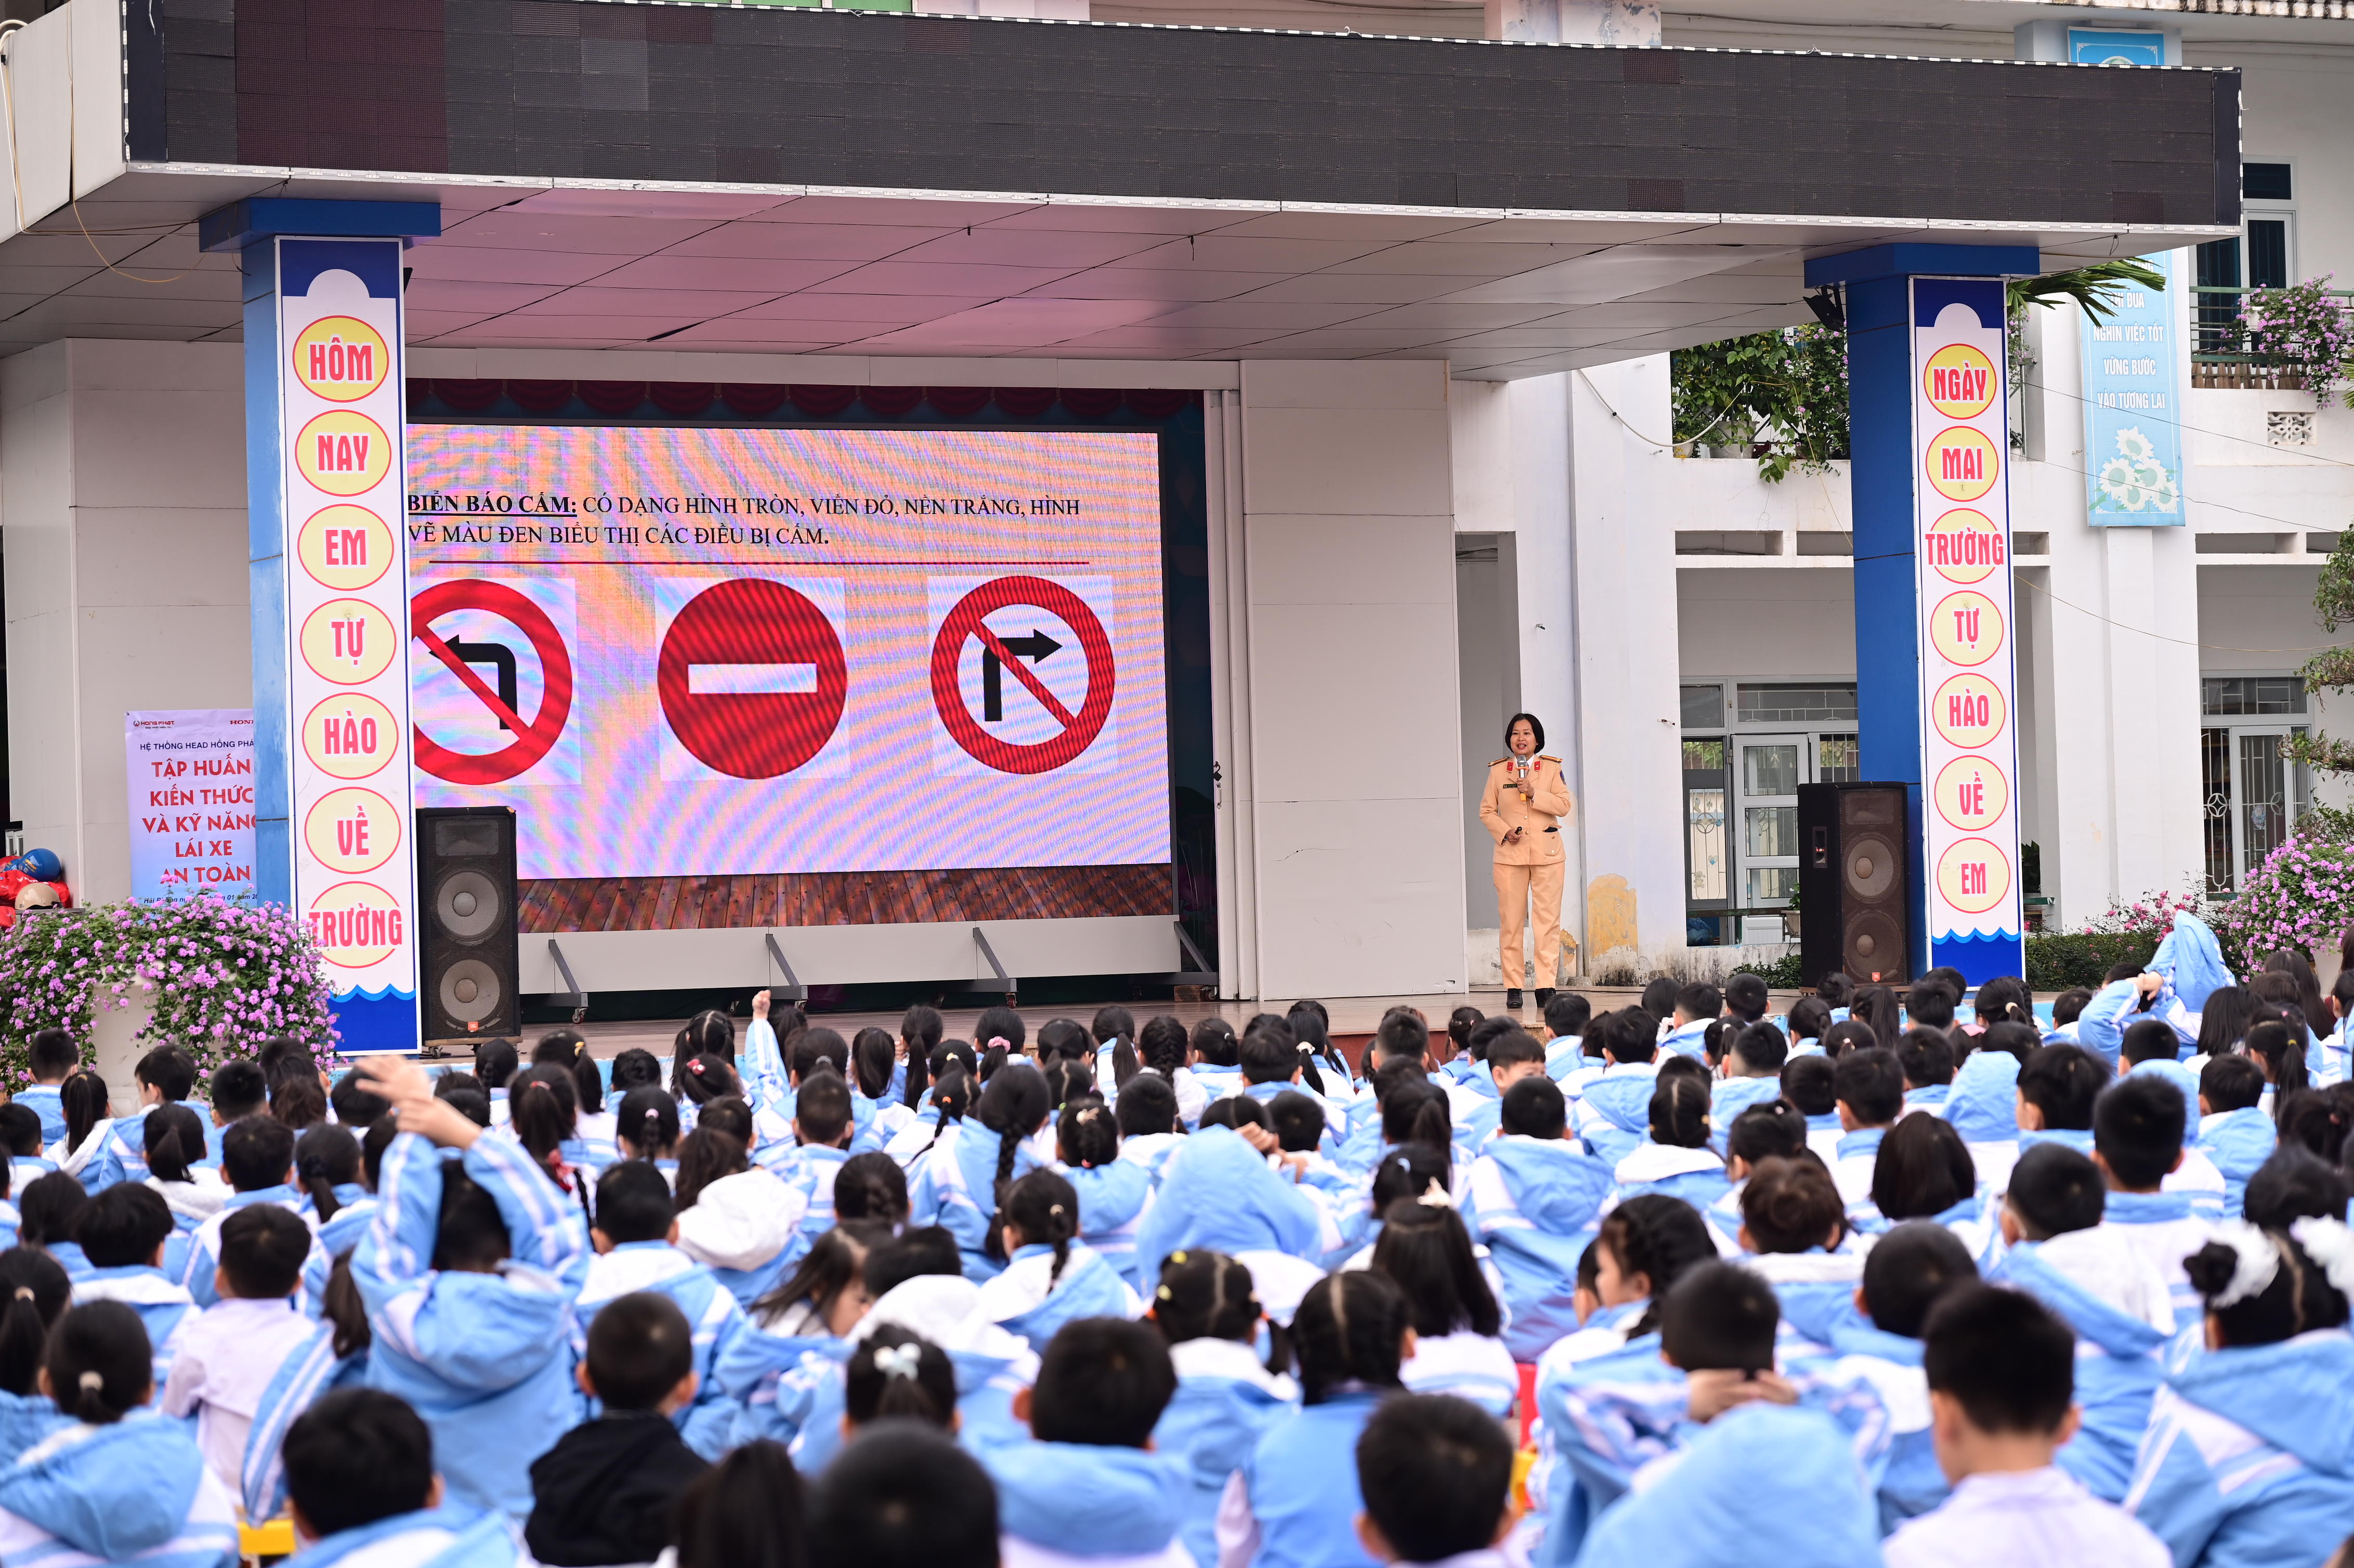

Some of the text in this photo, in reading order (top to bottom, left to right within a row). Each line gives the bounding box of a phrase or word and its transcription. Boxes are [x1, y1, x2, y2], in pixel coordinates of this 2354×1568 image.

[2126, 292, 2145, 308] ĐUA
[2093, 320, 2164, 345] NGHÌN VIỆC TỐT
[310, 337, 373, 381] HÔM
[2103, 356, 2156, 375] VỮNG BƯỚC
[1933, 362, 1986, 401] NGÀY
[2097, 389, 2165, 409] VÀO TƯƠNG LAI
[318, 435, 369, 471] NAY
[1942, 448, 1982, 479] MAI
[465, 491, 513, 513] BÁO
[583, 492, 612, 513] CÓ
[618, 497, 679, 516] DẠNG
[685, 493, 738, 514] HÌNH
[742, 493, 804, 517] TRÒN,
[864, 494, 899, 517] ĐỎ,
[950, 494, 1025, 518] TRẮNG,
[1030, 494, 1080, 515] HÌNH
[325, 529, 367, 565] EM
[409, 521, 829, 547] VẼ MÀU ĐEN BIỂU THỊ CÁC ĐIỀU BỊ CẤM.
[1925, 527, 2004, 565] TRƯỜNG
[332, 618, 364, 665] TỰ
[1954, 608, 1979, 649] TỰ
[1949, 689, 1989, 727] HÀO
[140, 742, 151, 752] HỆ
[153, 740, 183, 750] THỐNG
[211, 738, 235, 748] HỒNG
[324, 711, 376, 754] HÀO
[151, 753, 250, 780] TẬP HUẤN
[150, 783, 253, 806] KIẾN THỨC
[1959, 772, 1984, 815] VỀ
[142, 813, 171, 833] VÀ
[176, 813, 202, 832] KỸ
[337, 805, 369, 855] VỀ
[175, 838, 232, 858] LÁI XE
[194, 862, 250, 883] TOÀN
[1961, 863, 1986, 894] EM
[309, 902, 402, 947] TRƯỜNG
